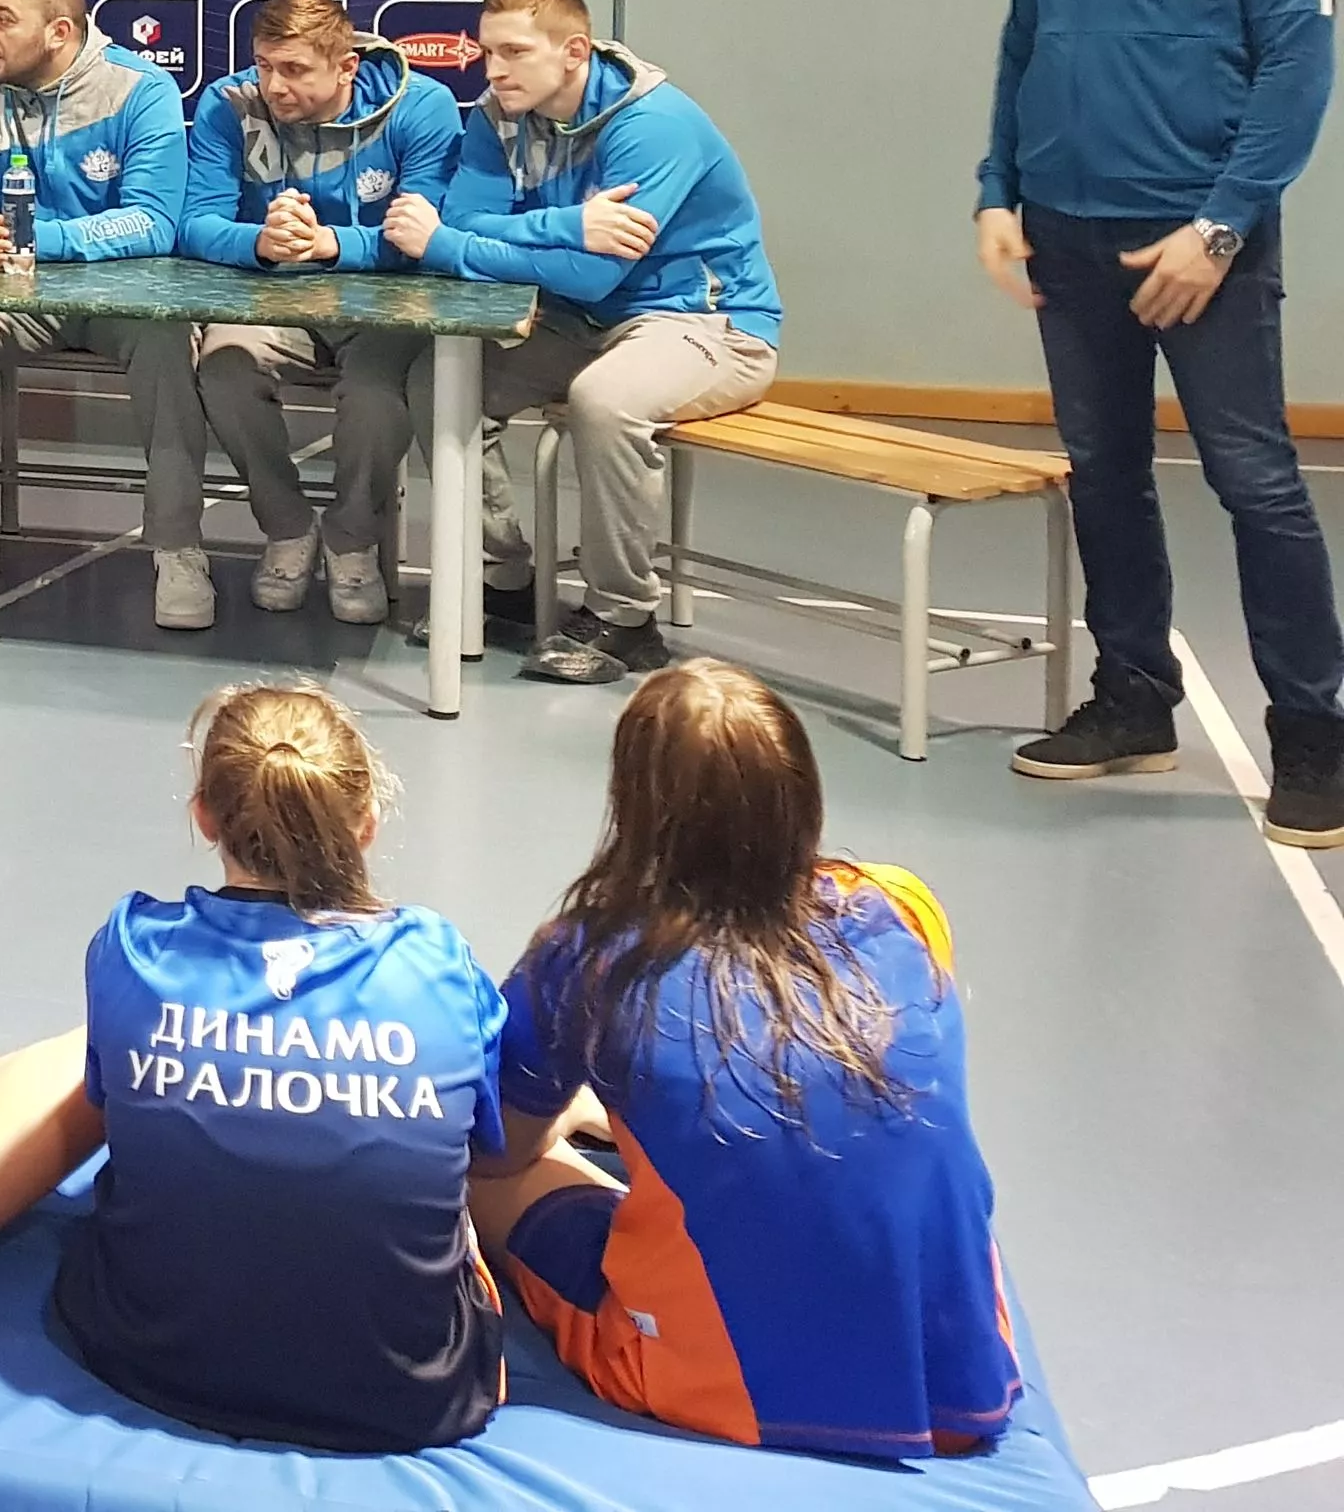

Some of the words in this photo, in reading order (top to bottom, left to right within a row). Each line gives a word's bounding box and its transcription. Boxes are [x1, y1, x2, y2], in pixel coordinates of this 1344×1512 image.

[132, 48, 185, 64] ФЕЙ
[79, 211, 156, 243] Kemp
[150, 1001, 417, 1066] ДИНАМО
[128, 1050, 445, 1120] УРАЛОЧКА
